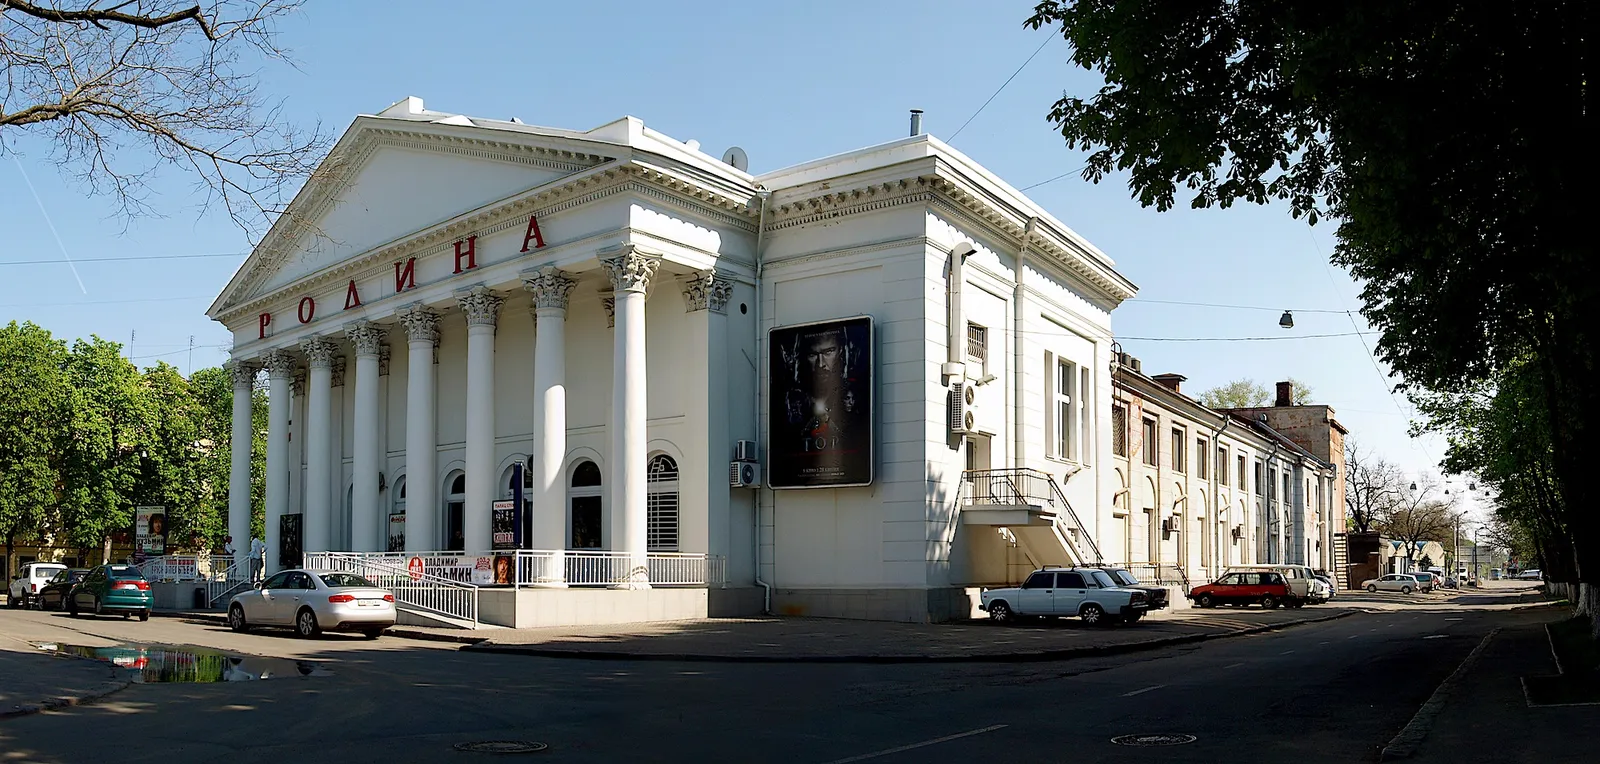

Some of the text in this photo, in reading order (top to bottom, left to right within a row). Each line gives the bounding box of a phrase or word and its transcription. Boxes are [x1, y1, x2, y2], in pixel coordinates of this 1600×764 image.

[258, 215, 547, 340] РОДИНА
[804, 437, 839, 451] ТОР
[424, 557, 459, 566] ВЛАДИМИР
[424, 567, 472, 582] КУЗЬМИН
